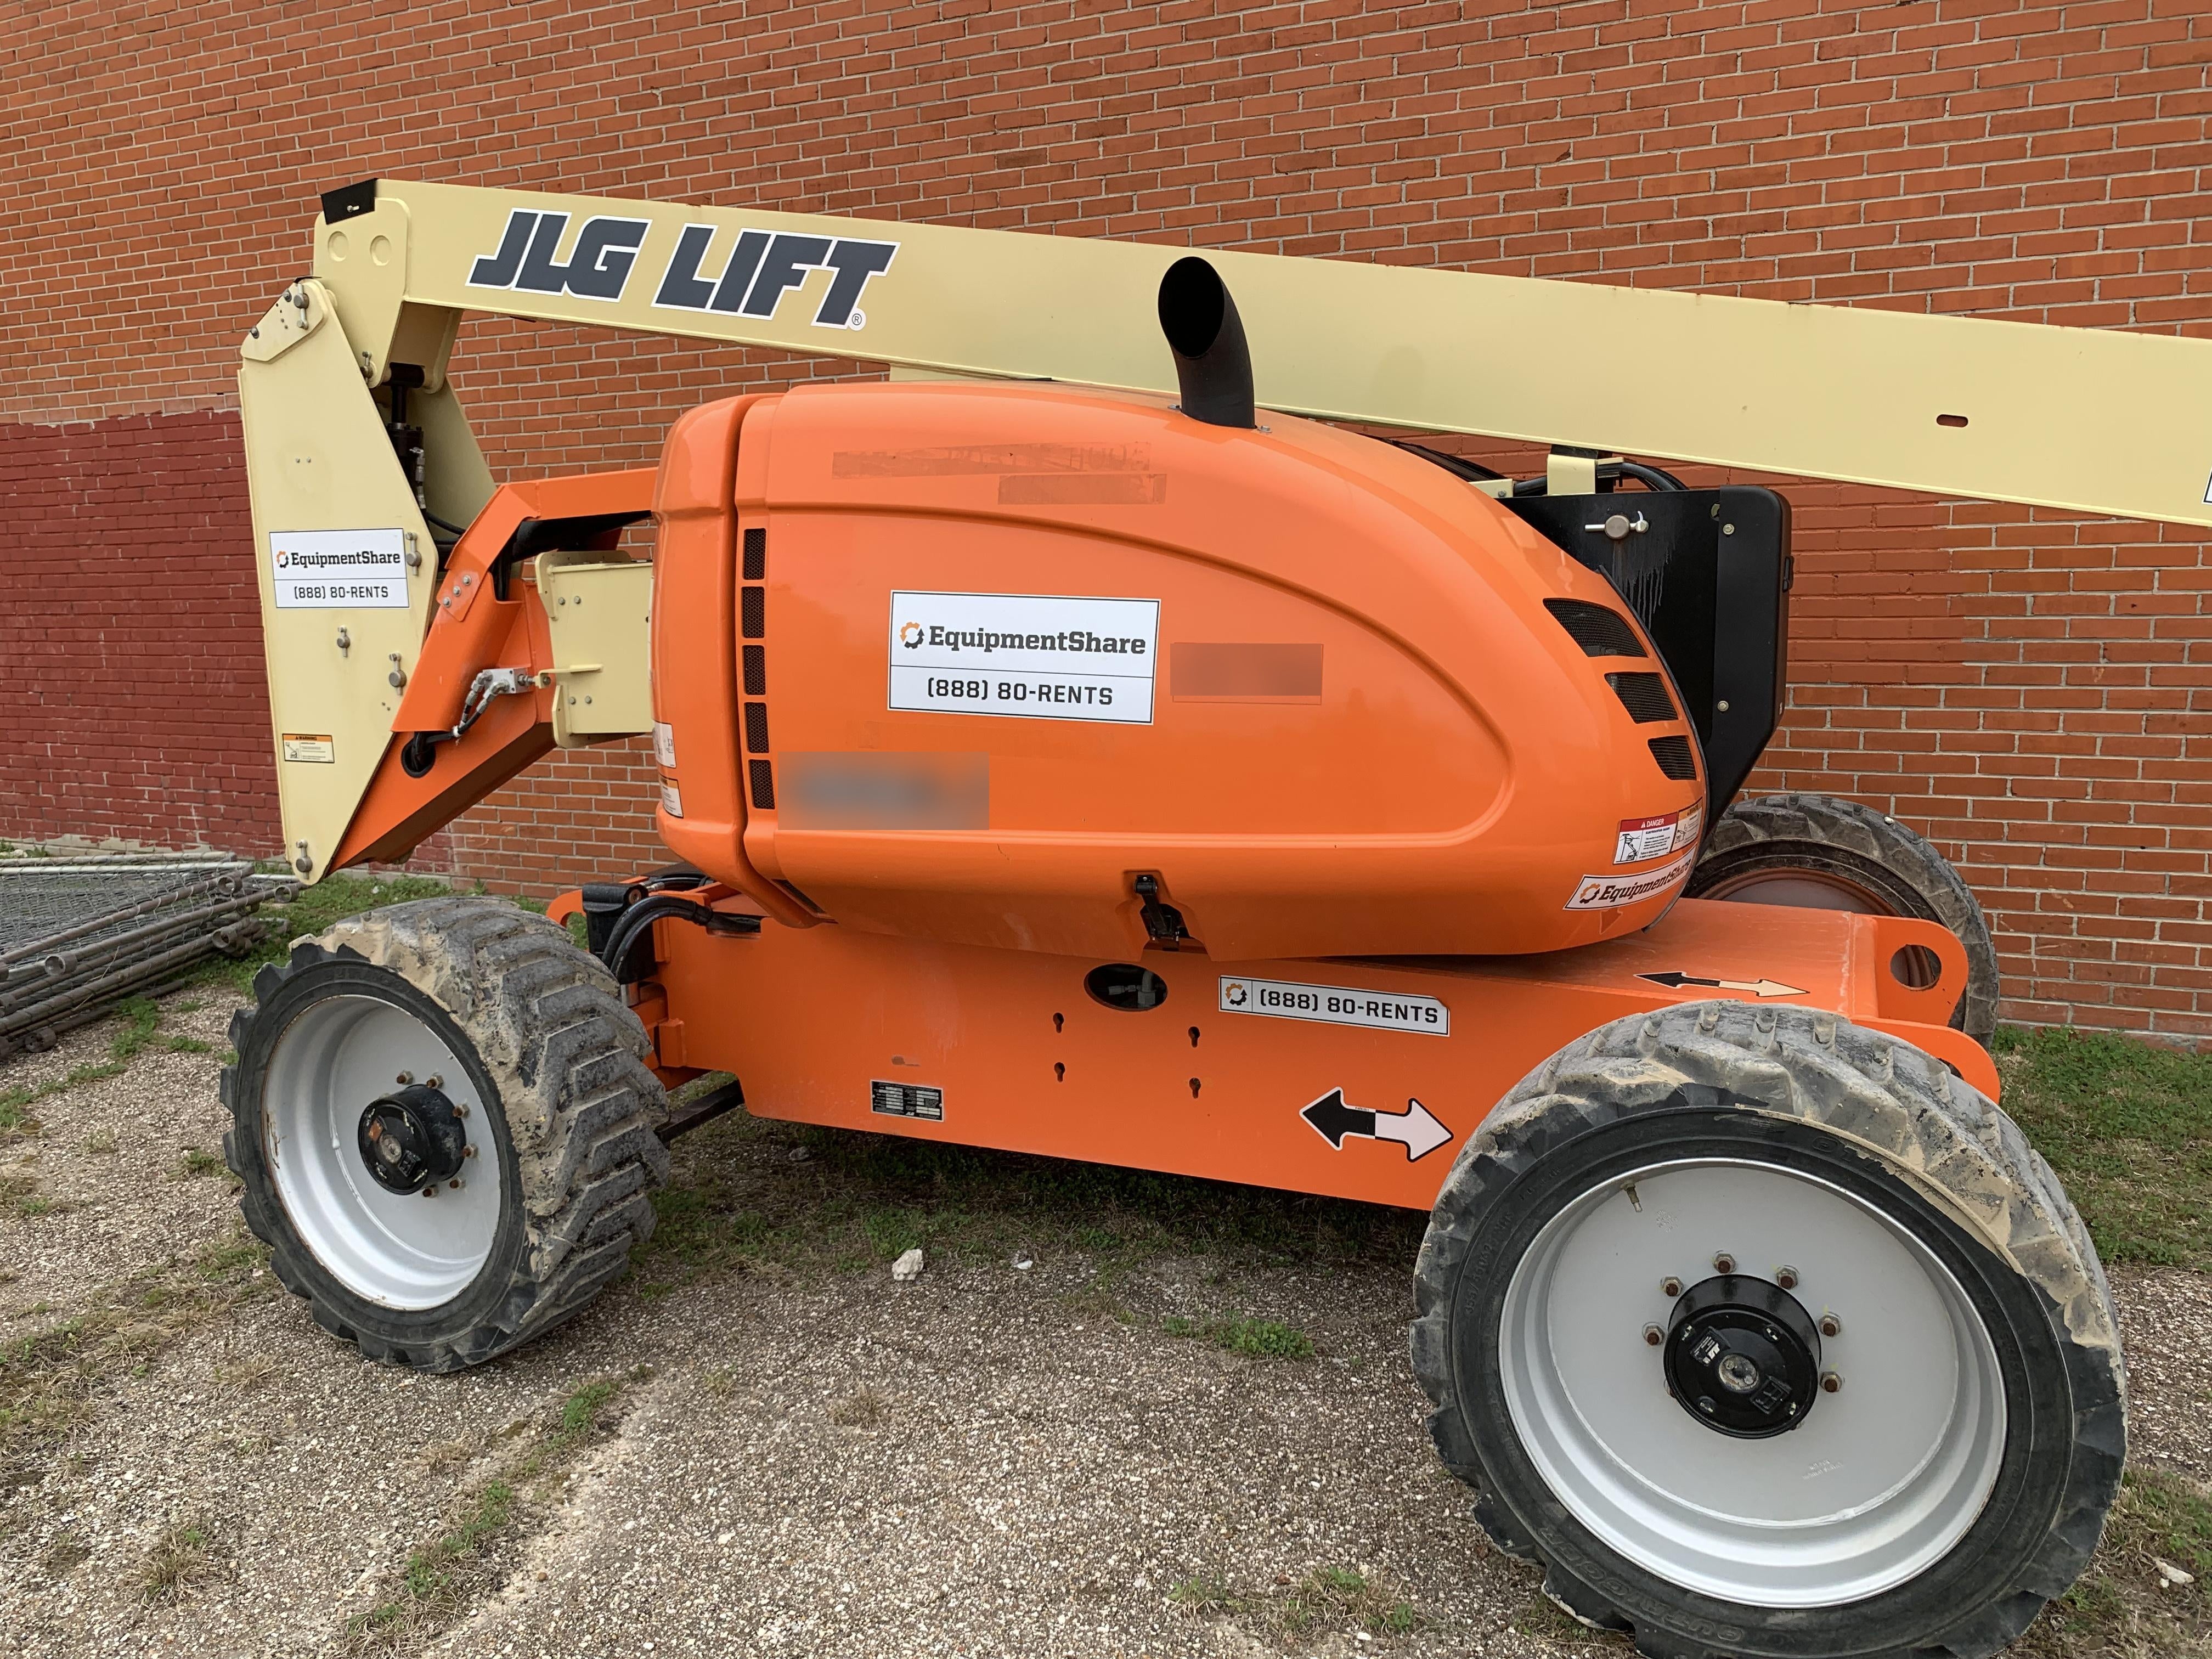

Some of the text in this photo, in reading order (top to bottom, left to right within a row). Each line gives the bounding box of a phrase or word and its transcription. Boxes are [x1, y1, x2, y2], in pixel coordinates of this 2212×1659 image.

[467, 209, 651, 301] JLG
[291, 551, 400, 568] EquipmentShare
[294, 586, 388, 599] (888) 80-RENTS
[929, 626, 1146, 654] EquipmentShare
[927, 678, 1113, 706] (888) 80-RENTS
[1646, 818, 1664, 827] DANGER
[1260, 989, 1438, 1024] (888) 80-RENTS
